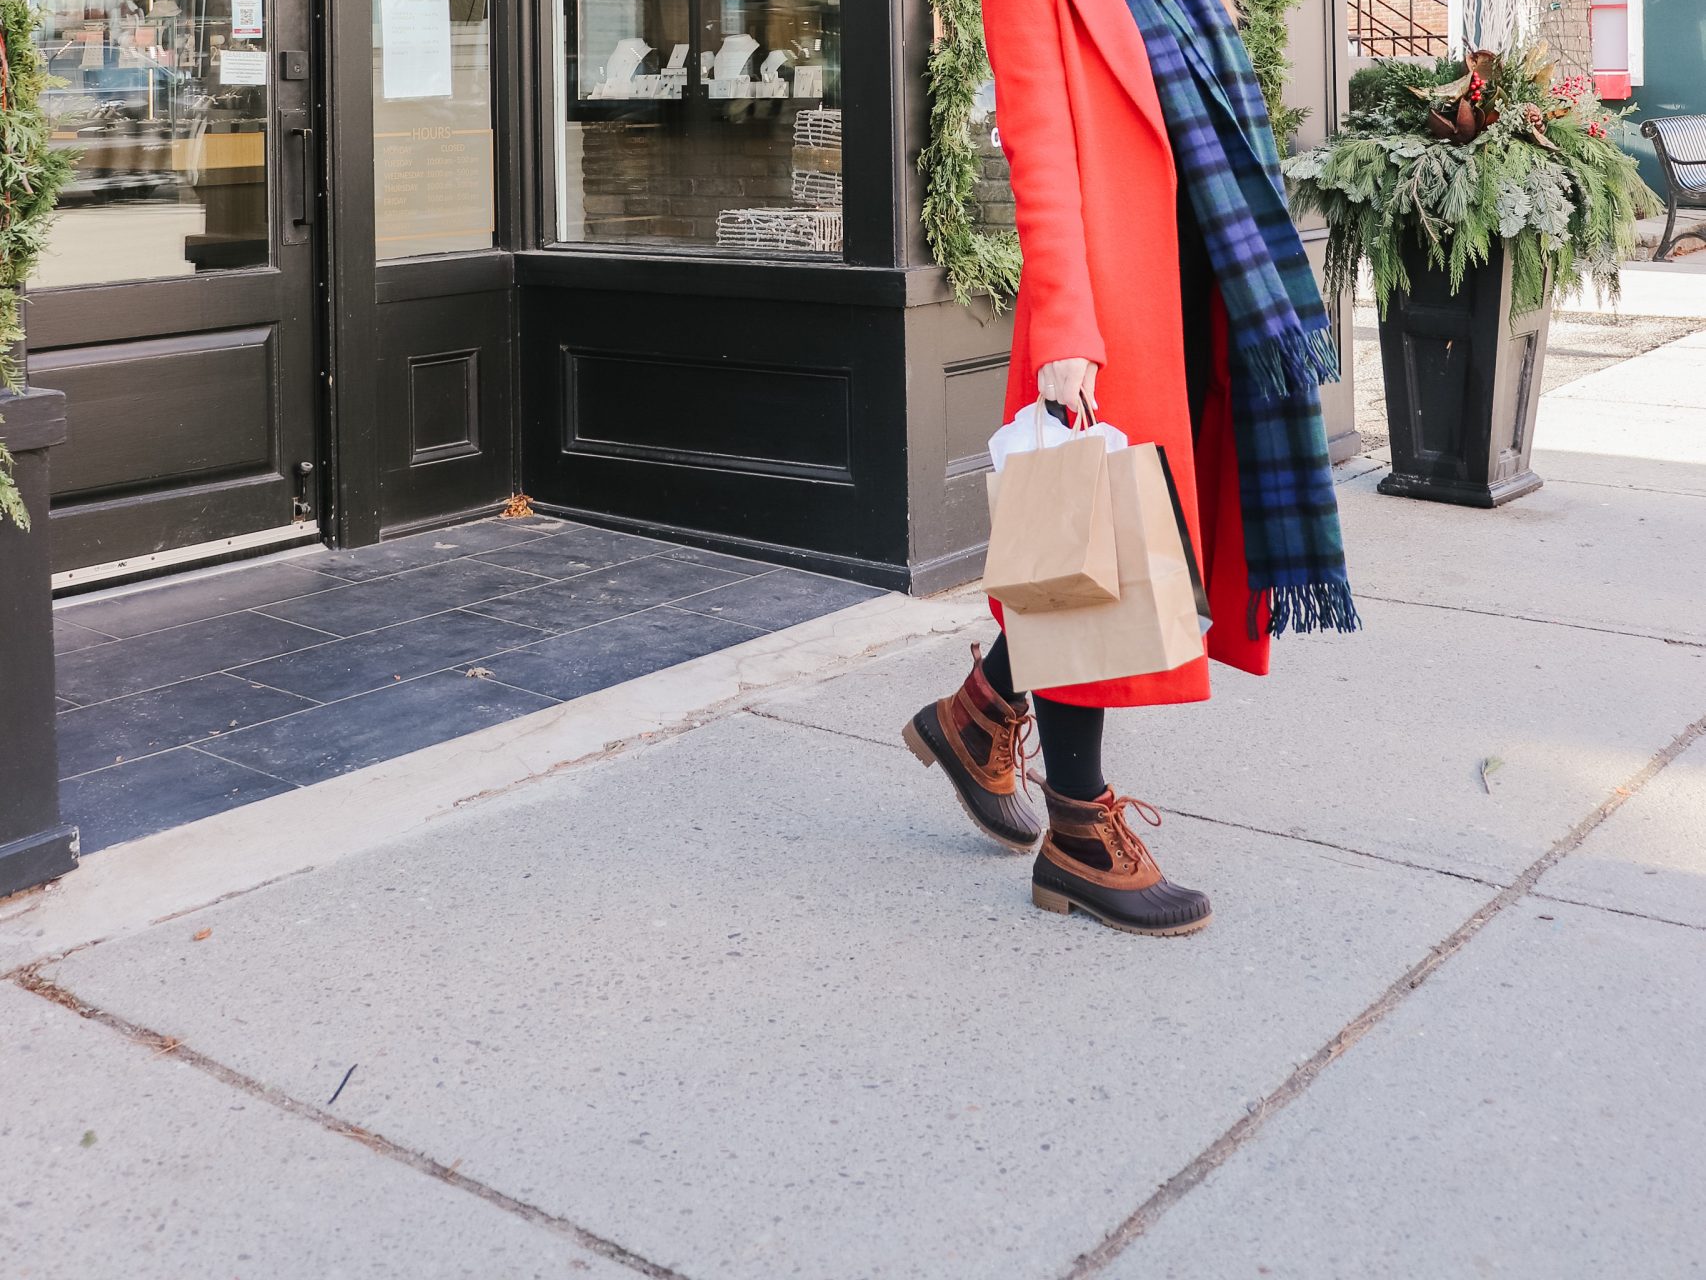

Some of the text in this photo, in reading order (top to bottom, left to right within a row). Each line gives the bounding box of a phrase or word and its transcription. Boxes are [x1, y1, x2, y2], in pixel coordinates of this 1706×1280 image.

[412, 127, 451, 140] HOURS
[440, 144, 465, 153] CLOSED
[384, 159, 412, 168] TUESDAY
[384, 171, 424, 180] WEDNESDAY
[384, 184, 417, 193] THURSDAY
